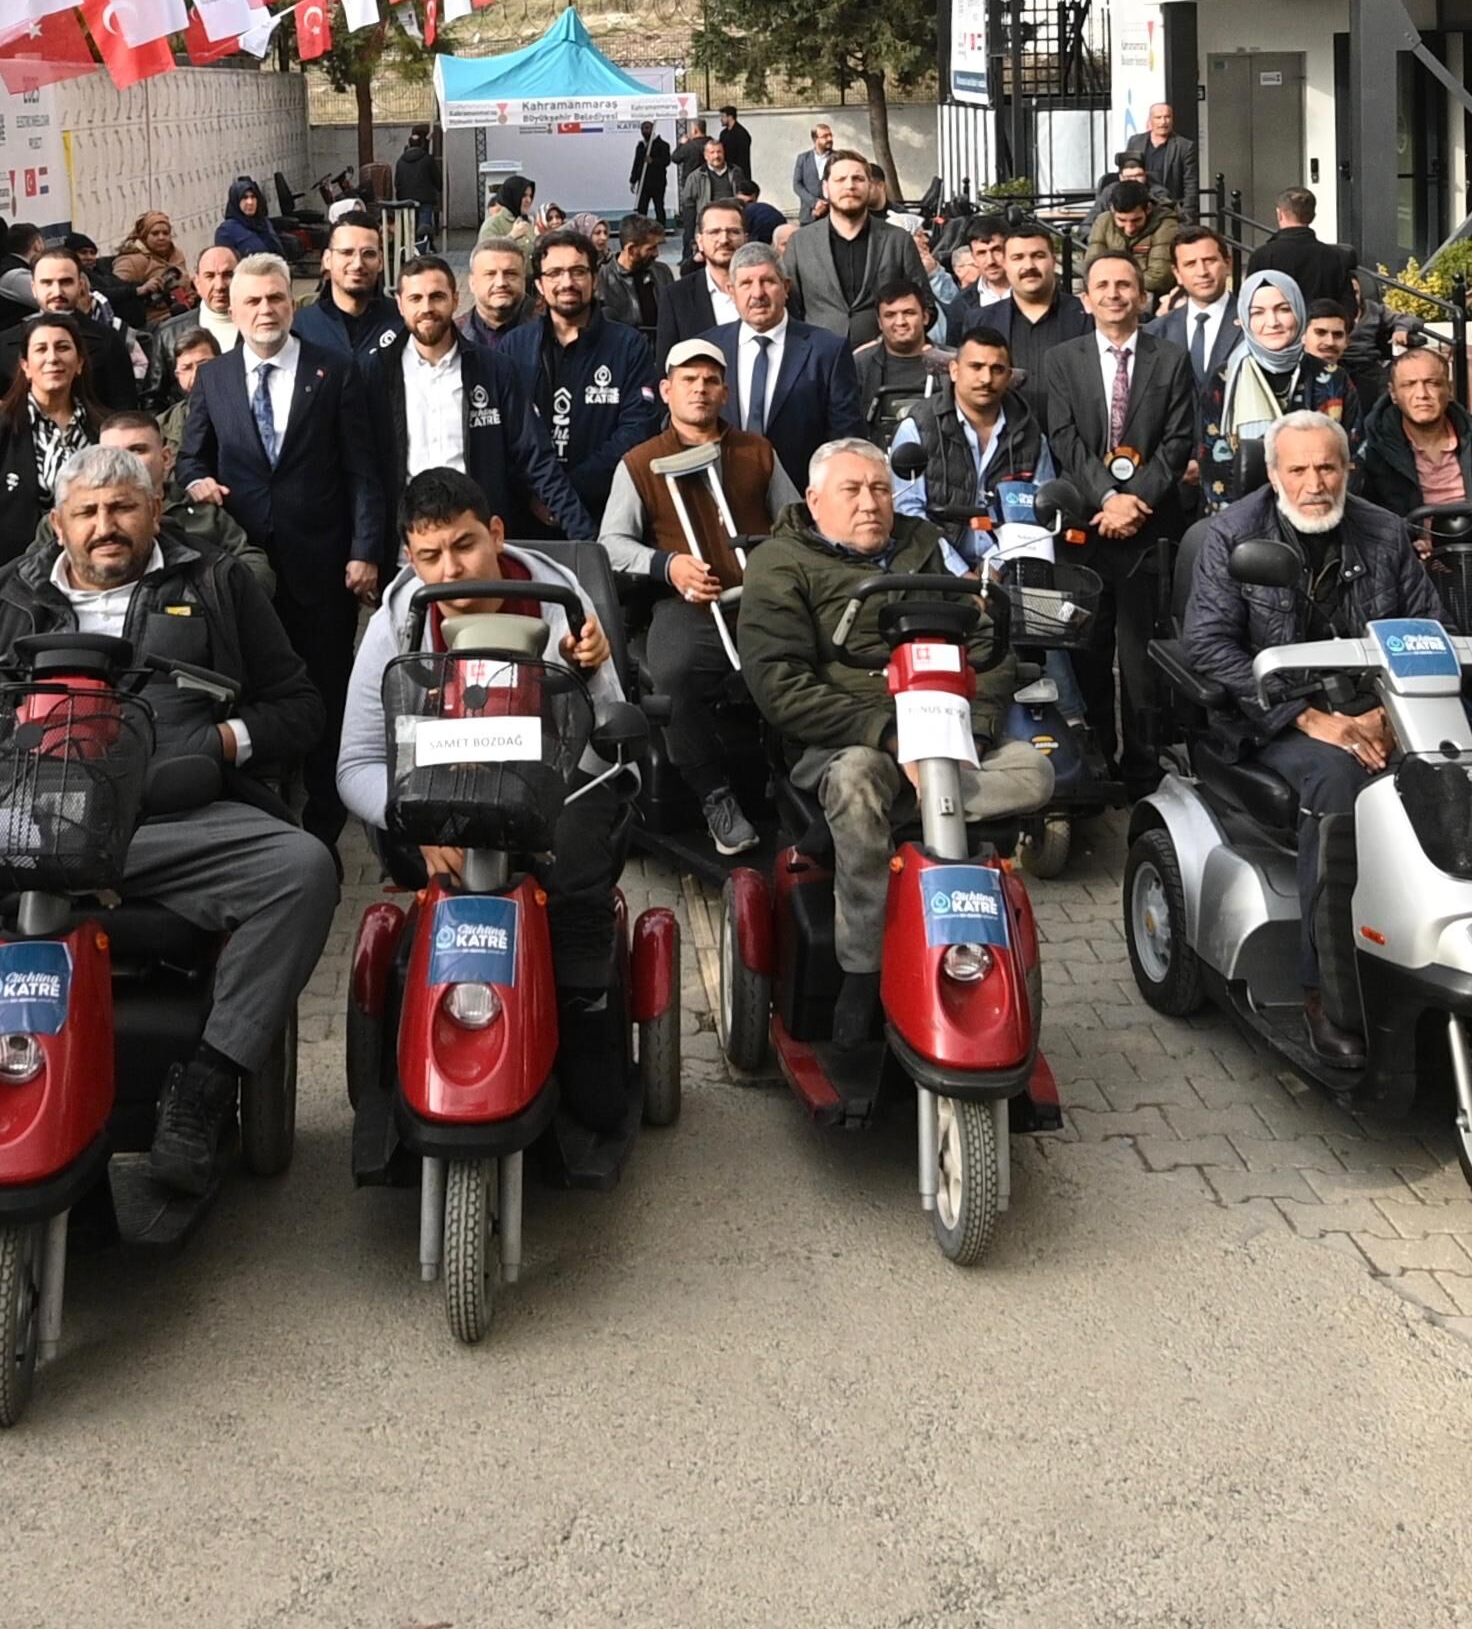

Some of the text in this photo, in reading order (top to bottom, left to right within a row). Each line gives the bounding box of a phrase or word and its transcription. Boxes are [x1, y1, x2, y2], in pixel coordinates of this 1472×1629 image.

[521, 99, 618, 112] Kahramanmaraş
[522, 113, 572, 124] Büyükşehir
[574, 111, 619, 122] Belediyesi
[585, 393, 620, 404] KATRE
[429, 734, 523, 750] SAMET BOZDAĞ
[952, 900, 999, 916] KATRE
[456, 934, 508, 950] KATRE
[3, 982, 61, 998] KATRE
